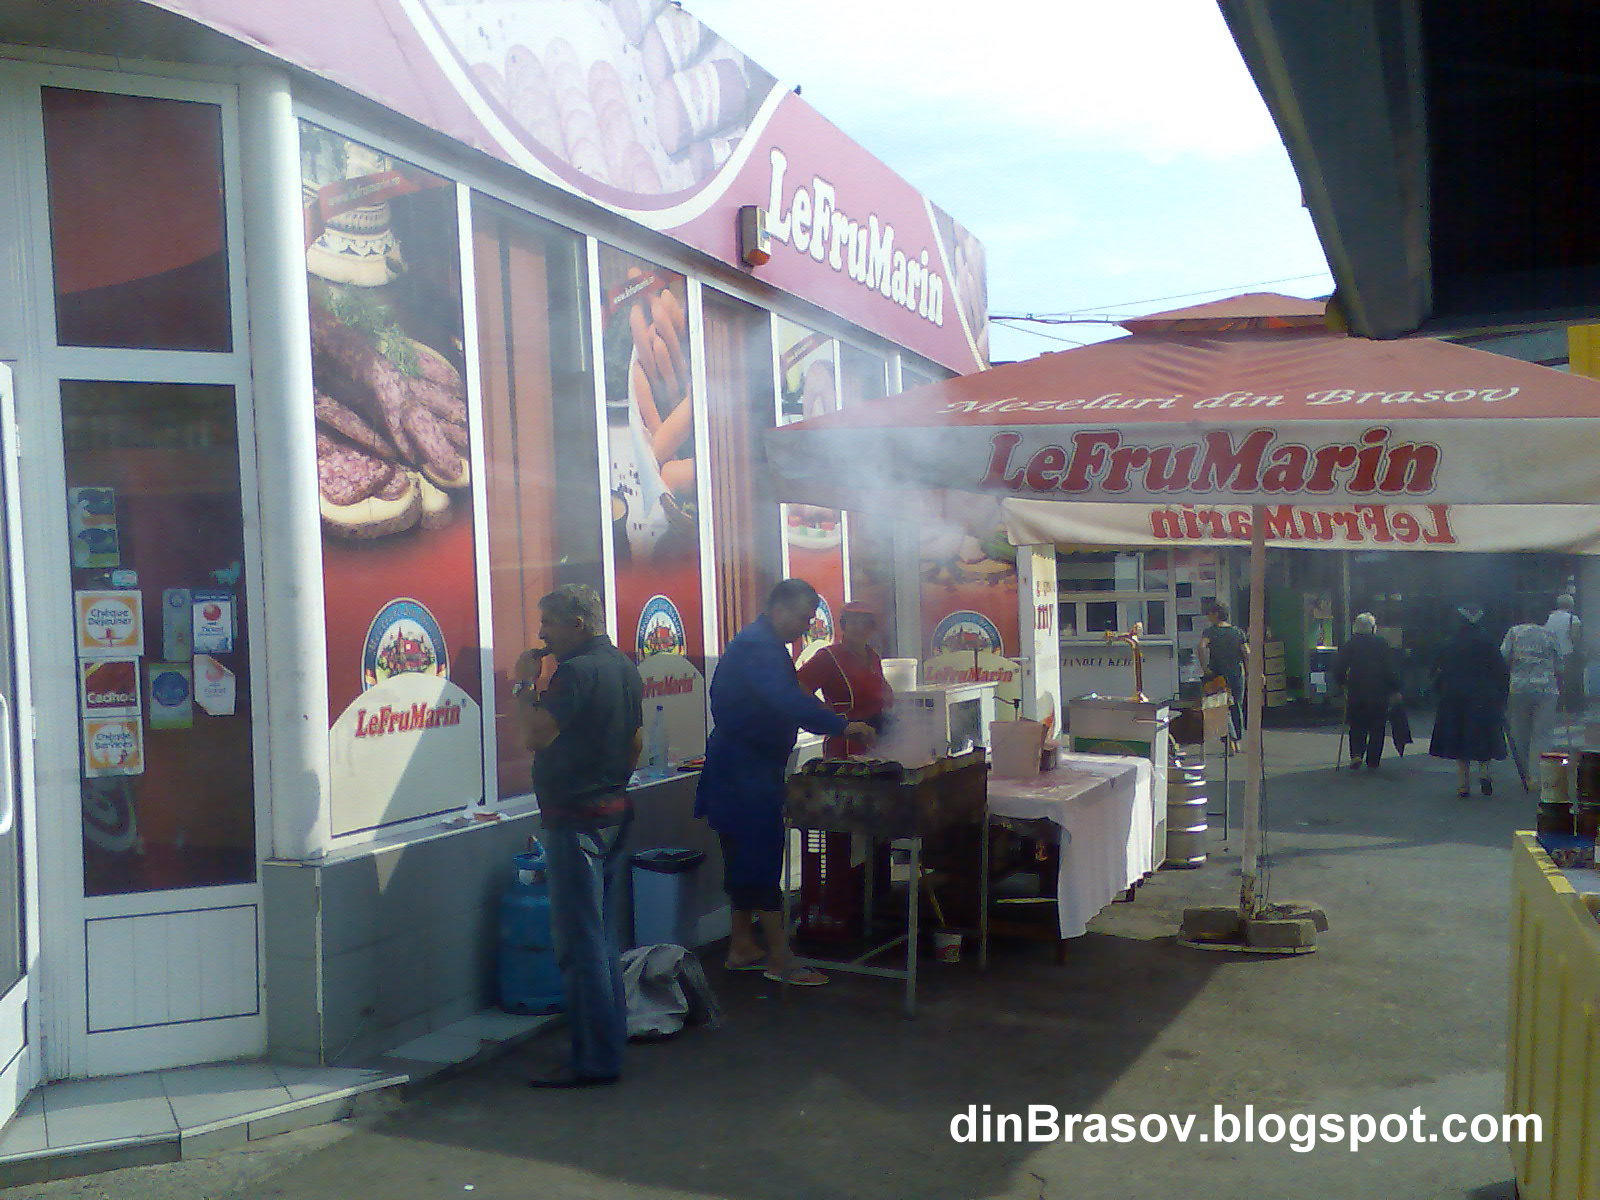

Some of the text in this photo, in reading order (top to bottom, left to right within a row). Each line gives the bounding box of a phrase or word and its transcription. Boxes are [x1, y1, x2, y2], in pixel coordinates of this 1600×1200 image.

[766, 146, 944, 328] LeFruMarin
[936, 386, 1521, 414] Mezeluri din Brasov
[980, 427, 1442, 495] LeFruMarin
[355, 699, 462, 739] LeFruMarin
